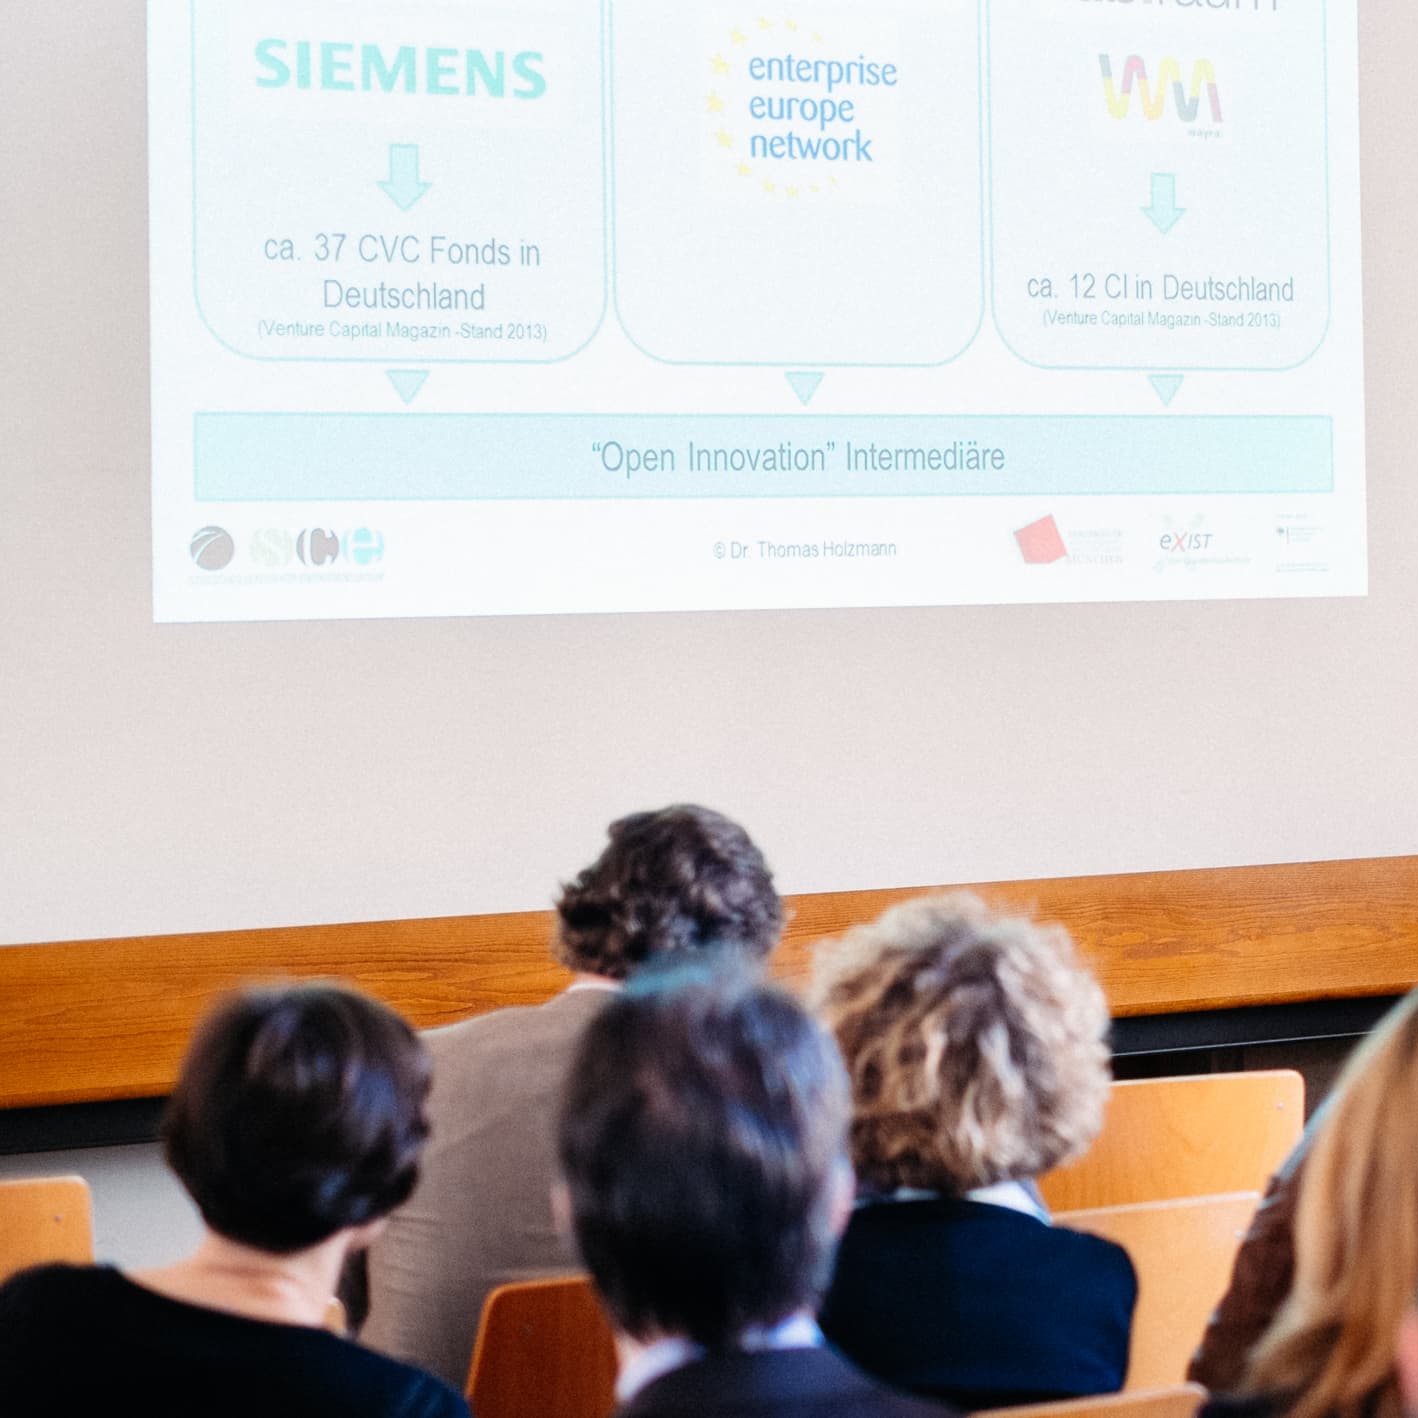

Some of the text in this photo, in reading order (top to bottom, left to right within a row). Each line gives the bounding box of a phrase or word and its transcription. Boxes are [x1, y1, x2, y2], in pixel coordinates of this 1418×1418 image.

[254, 37, 548, 101] SIEMENS
[748, 53, 898, 94] enterprise
[749, 96, 856, 132] europe
[749, 127, 873, 162] network
[263, 232, 541, 267] ca. 37 CVC Fonds in
[323, 279, 486, 311] Deutschland
[1026, 277, 1058, 299] ca.
[1070, 272, 1096, 299] 12
[1135, 273, 1153, 300] in
[1163, 273, 1294, 303] Deutschland
[257, 319, 326, 340] (Venture
[328, 319, 382, 341] Capital
[385, 320, 452, 343] Magazin
[506, 321, 548, 344] 2013)
[1042, 308, 1098, 328] (Venture
[1100, 309, 1147, 329] Capital
[1146, 311, 1202, 331] Magazin
[1245, 311, 1281, 330] 2013)
[591, 440, 1006, 480] “Open Innovation” Intermediäre
[729, 540, 753, 560] Dr.
[756, 540, 820, 559] Thomas
[822, 540, 897, 558] Holzmann
